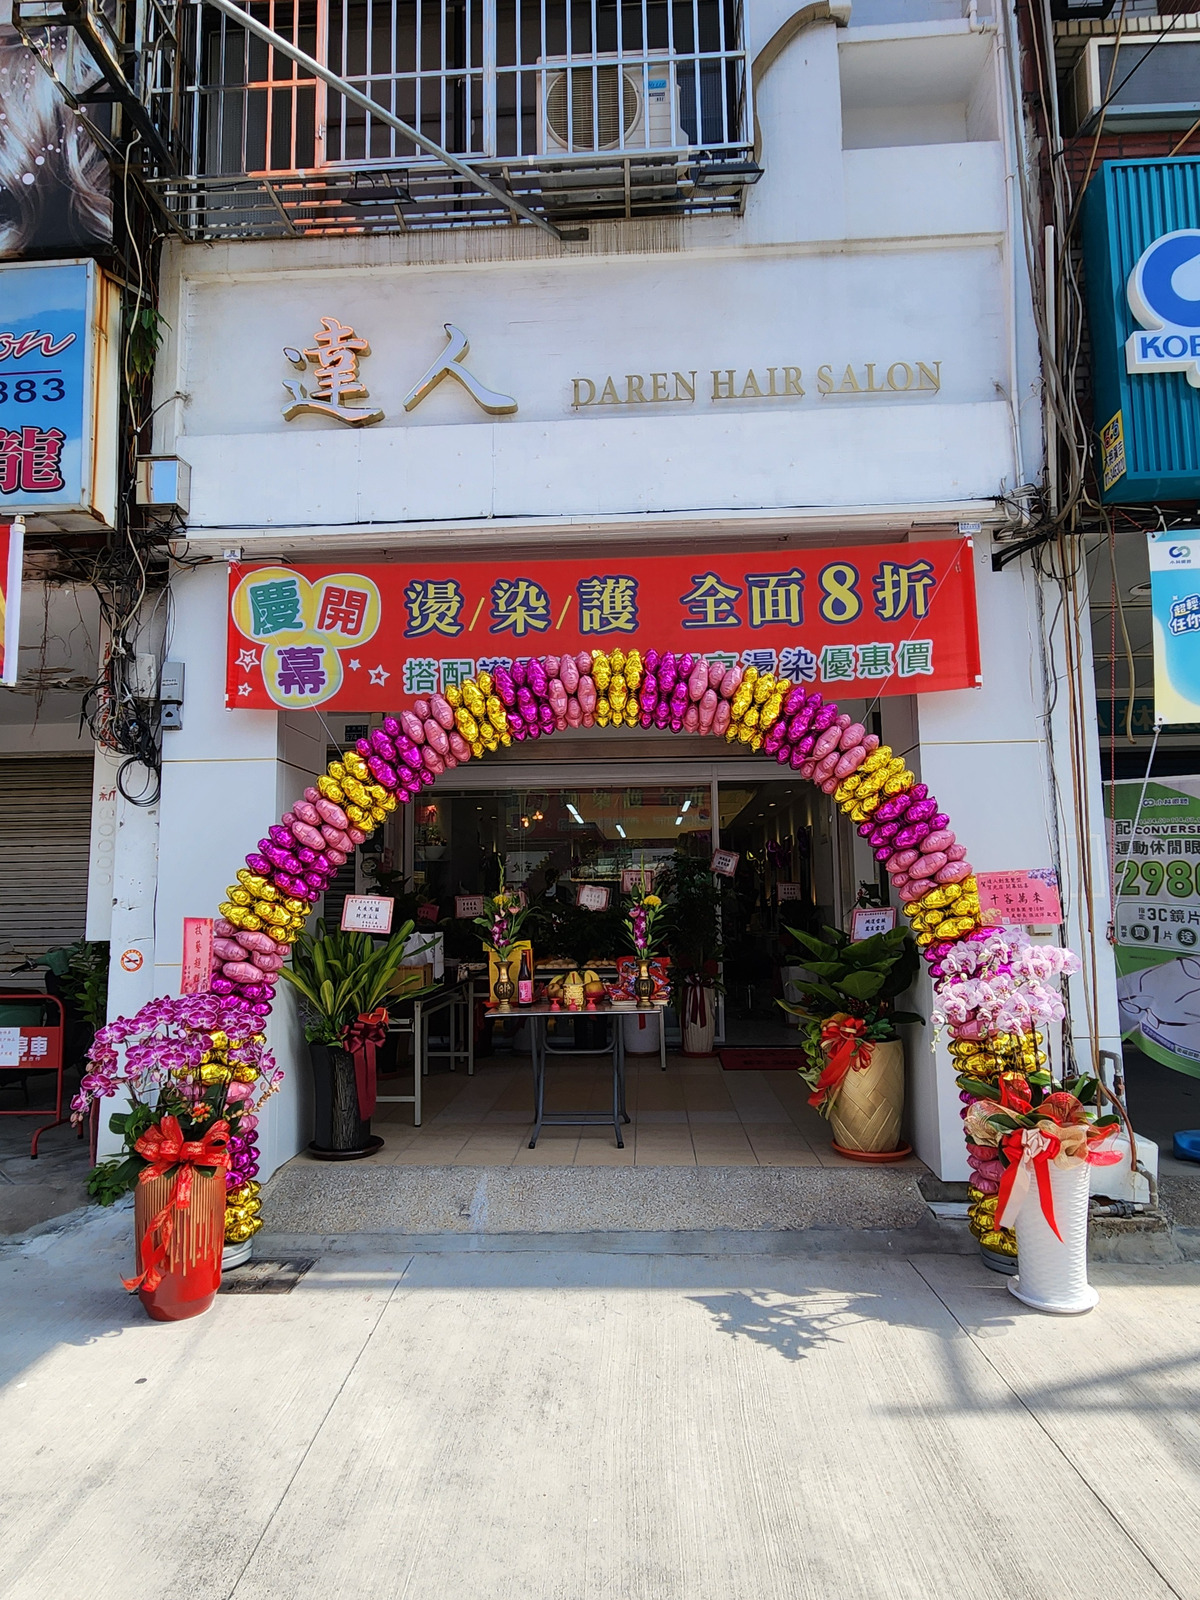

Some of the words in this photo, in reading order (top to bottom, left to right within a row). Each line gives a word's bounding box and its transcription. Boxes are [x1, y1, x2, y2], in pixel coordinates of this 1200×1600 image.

[281, 317, 518, 427] 達人
[571, 371, 697, 407] DAREN
[710, 366, 805, 399] HAIR
[816, 361, 942, 395] SALON
[681, 560, 936, 629] 全面8折
[1115, 860, 1200, 898] 298
